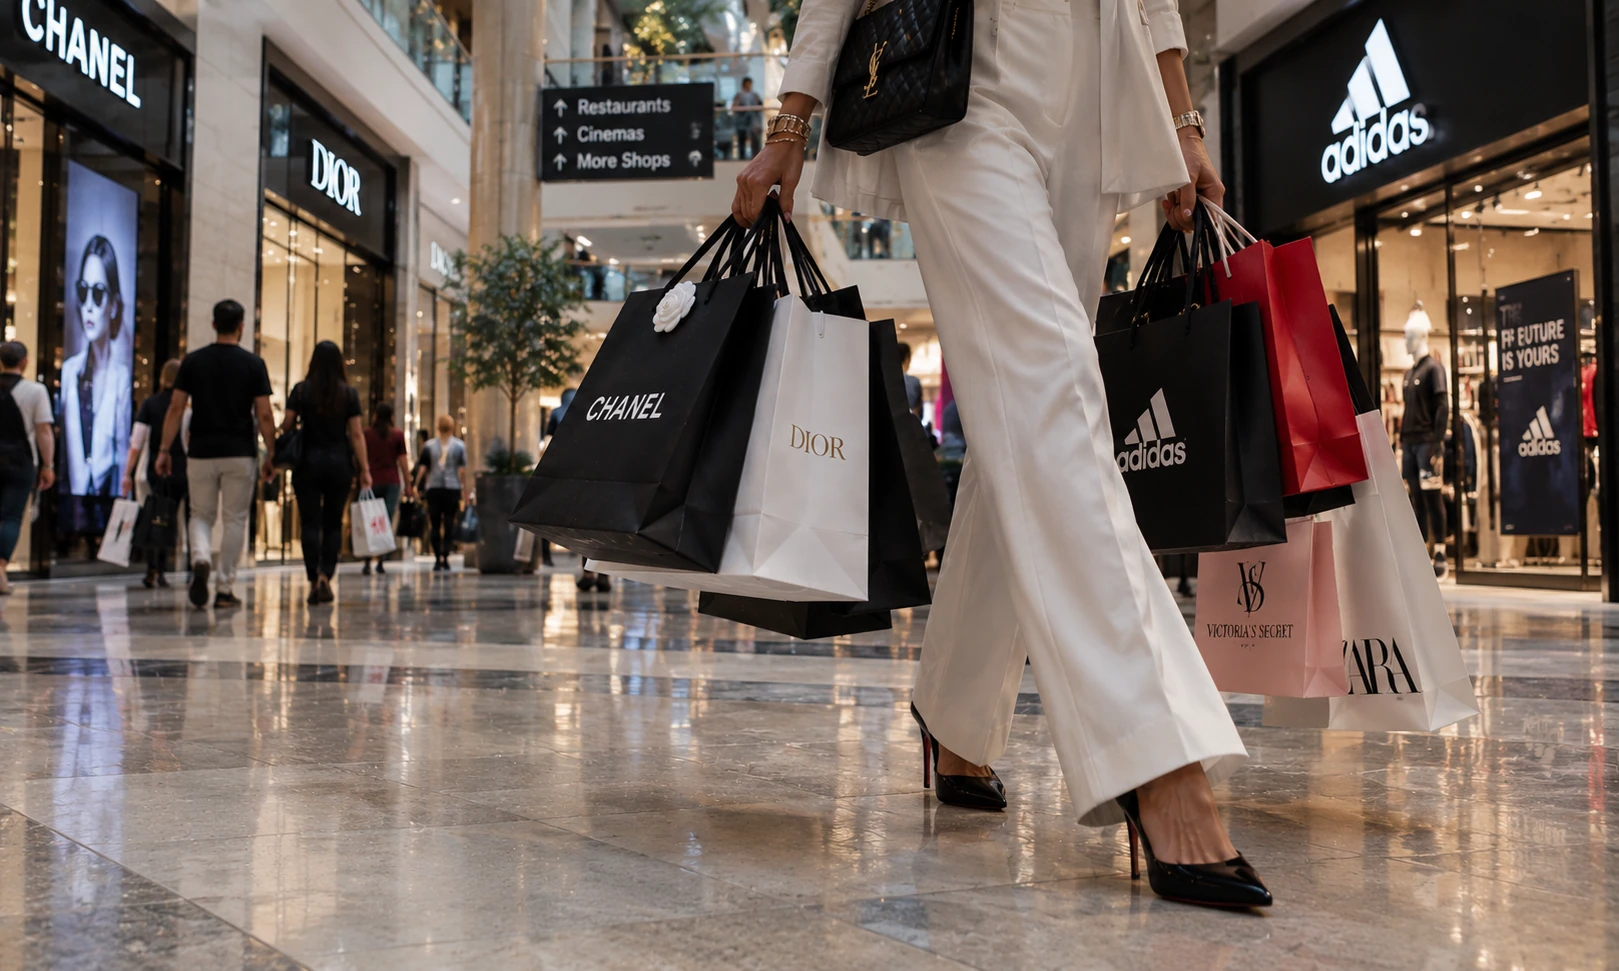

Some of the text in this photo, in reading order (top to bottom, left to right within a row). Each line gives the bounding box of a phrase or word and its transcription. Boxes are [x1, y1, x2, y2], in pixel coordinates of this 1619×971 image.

[21, 0, 141, 109] CHANEL
[577, 98, 671, 115] Restaurants
[577, 126, 645, 142] Cinemas
[1321, 103, 1430, 184] adidas
[577, 152, 671, 172] More Shops
[310, 138, 362, 217] DIOR
[1501, 343, 1559, 371] IS YOURS
[586, 392, 665, 421] CHANEL
[790, 424, 846, 460] DIOR
[1518, 438, 1561, 457] adidas
[1116, 440, 1187, 473] adidas
[1207, 623, 1257, 638] VICTORIA'S
